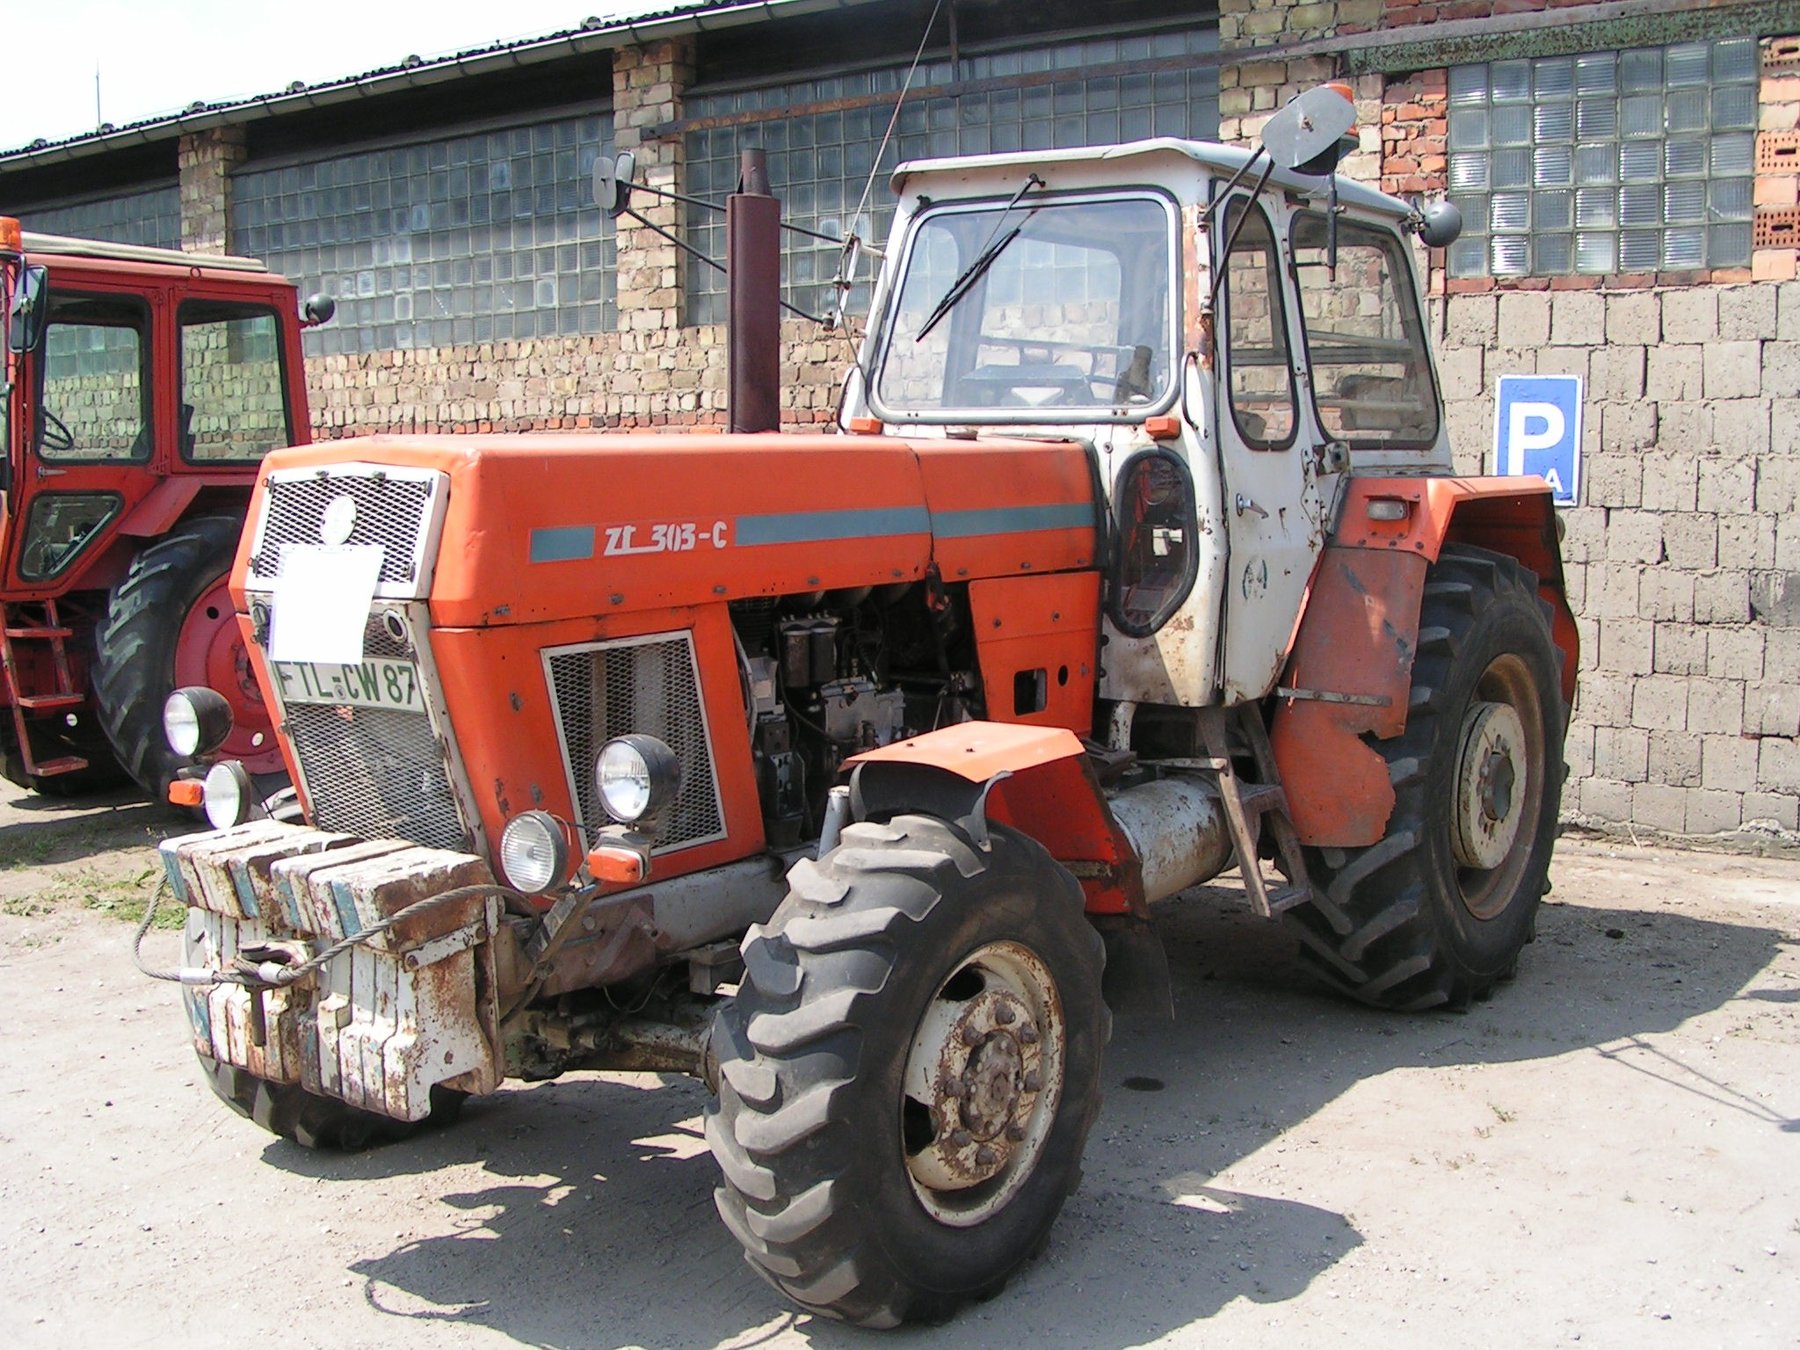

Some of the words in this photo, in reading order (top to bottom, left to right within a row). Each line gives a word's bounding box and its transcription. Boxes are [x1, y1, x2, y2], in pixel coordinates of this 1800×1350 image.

[1507, 402, 1565, 476] P
[651, 521, 728, 552] 303-C
[383, 664, 415, 705] 87
